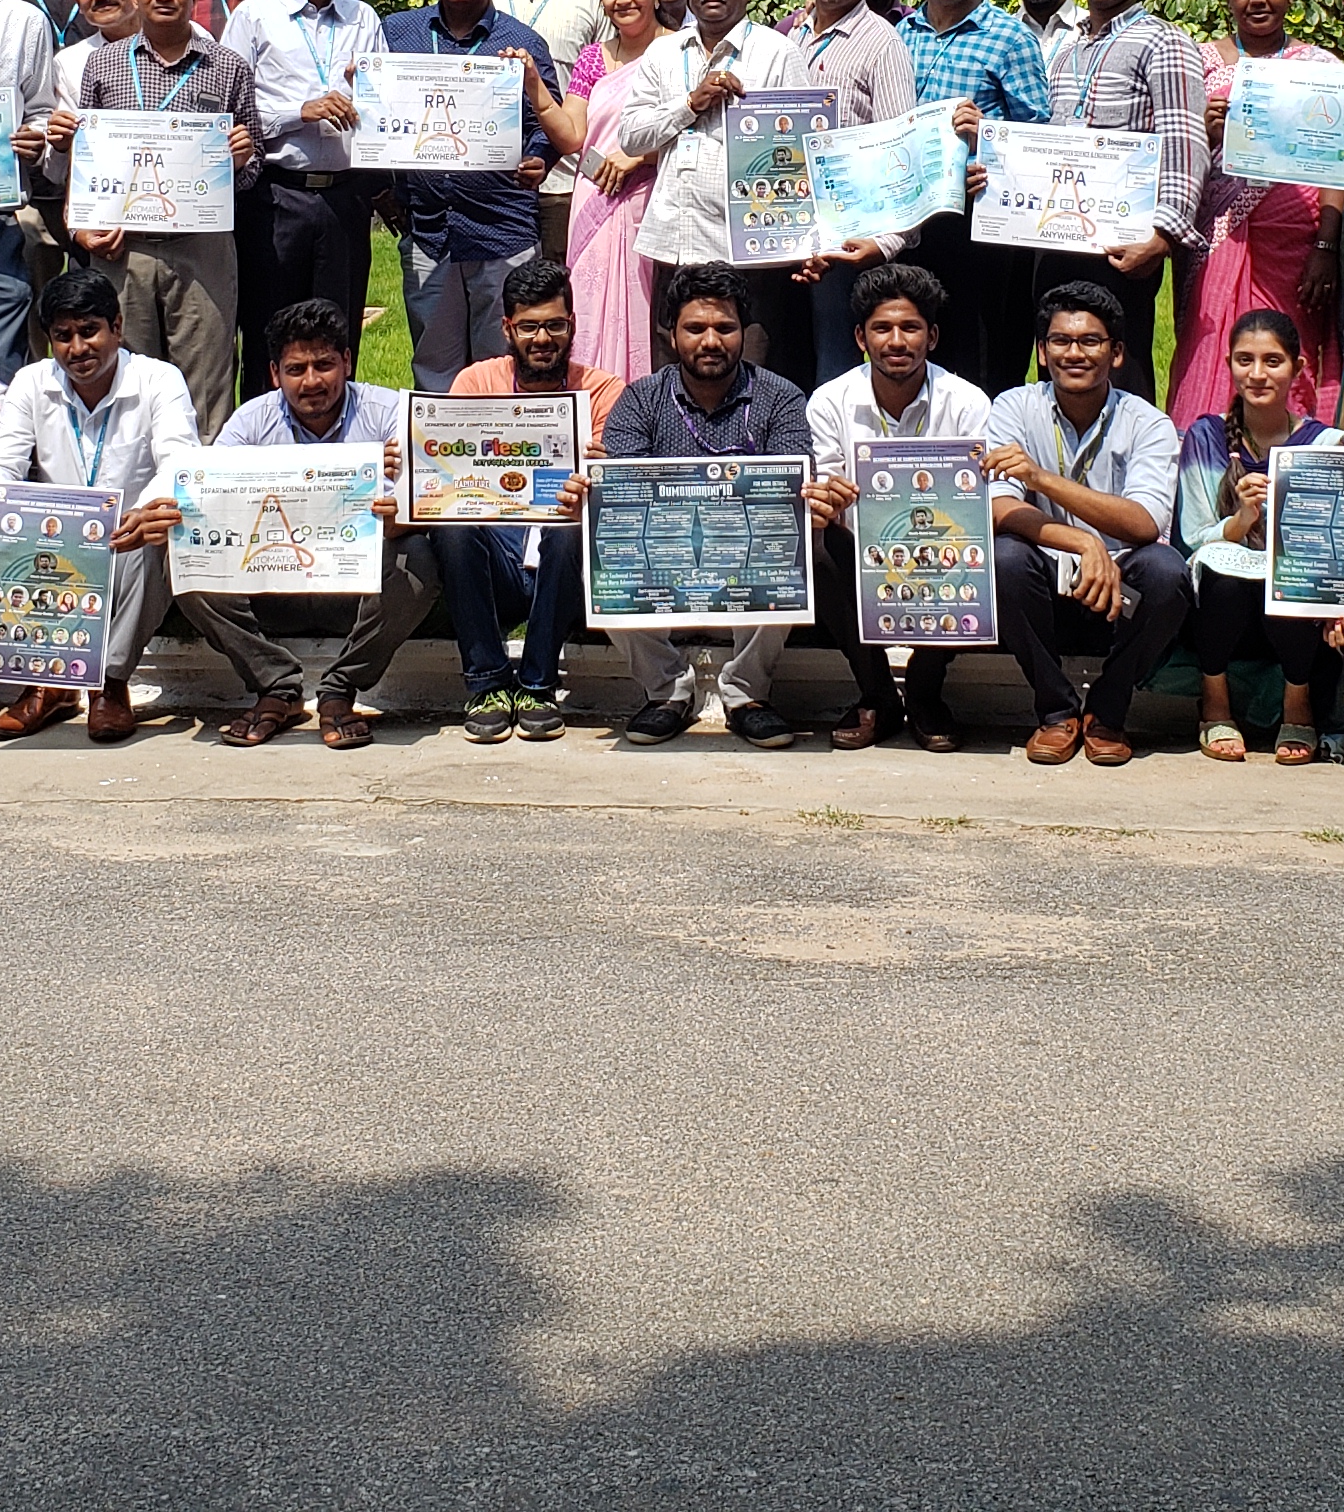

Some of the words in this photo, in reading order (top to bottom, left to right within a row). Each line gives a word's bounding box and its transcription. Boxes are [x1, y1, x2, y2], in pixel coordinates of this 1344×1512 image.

[425, 94, 457, 109] RPA
[133, 153, 165, 168] RPA
[416, 153, 460, 161] ANYWHERE
[1052, 169, 1086, 186] RPA
[125, 213, 168, 222] ANYWHERE
[1039, 230, 1087, 242] ANYWHERE
[424, 439, 477, 457] Code
[481, 437, 542, 457] Fiesta
[262, 505, 282, 514] RPA
[246, 563, 303, 574] ANYWHERE
